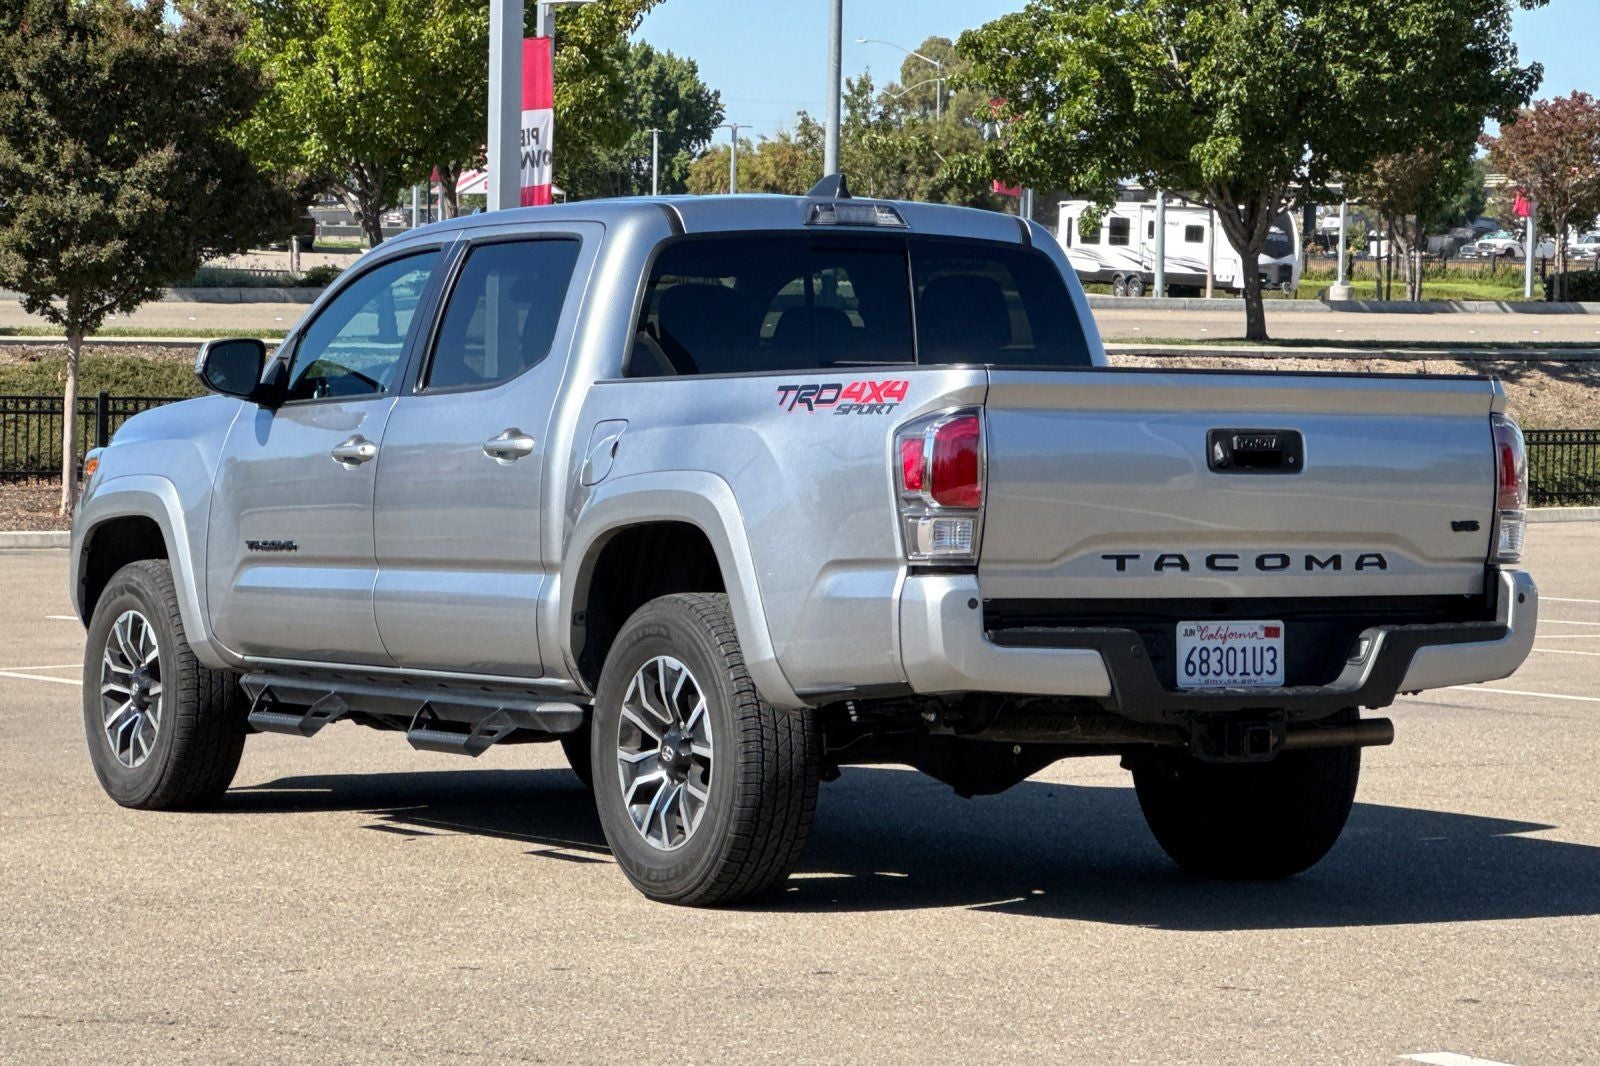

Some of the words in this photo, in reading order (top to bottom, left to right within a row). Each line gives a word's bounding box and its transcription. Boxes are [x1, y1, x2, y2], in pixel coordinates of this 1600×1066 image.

[777, 383, 843, 413] TRD
[833, 402, 899, 415] SPORT
[1101, 553, 1388, 571] TACOMA
[1182, 628, 1196, 637] JUN
[1199, 624, 1264, 645] California
[1184, 646, 1278, 677] 68301U3
